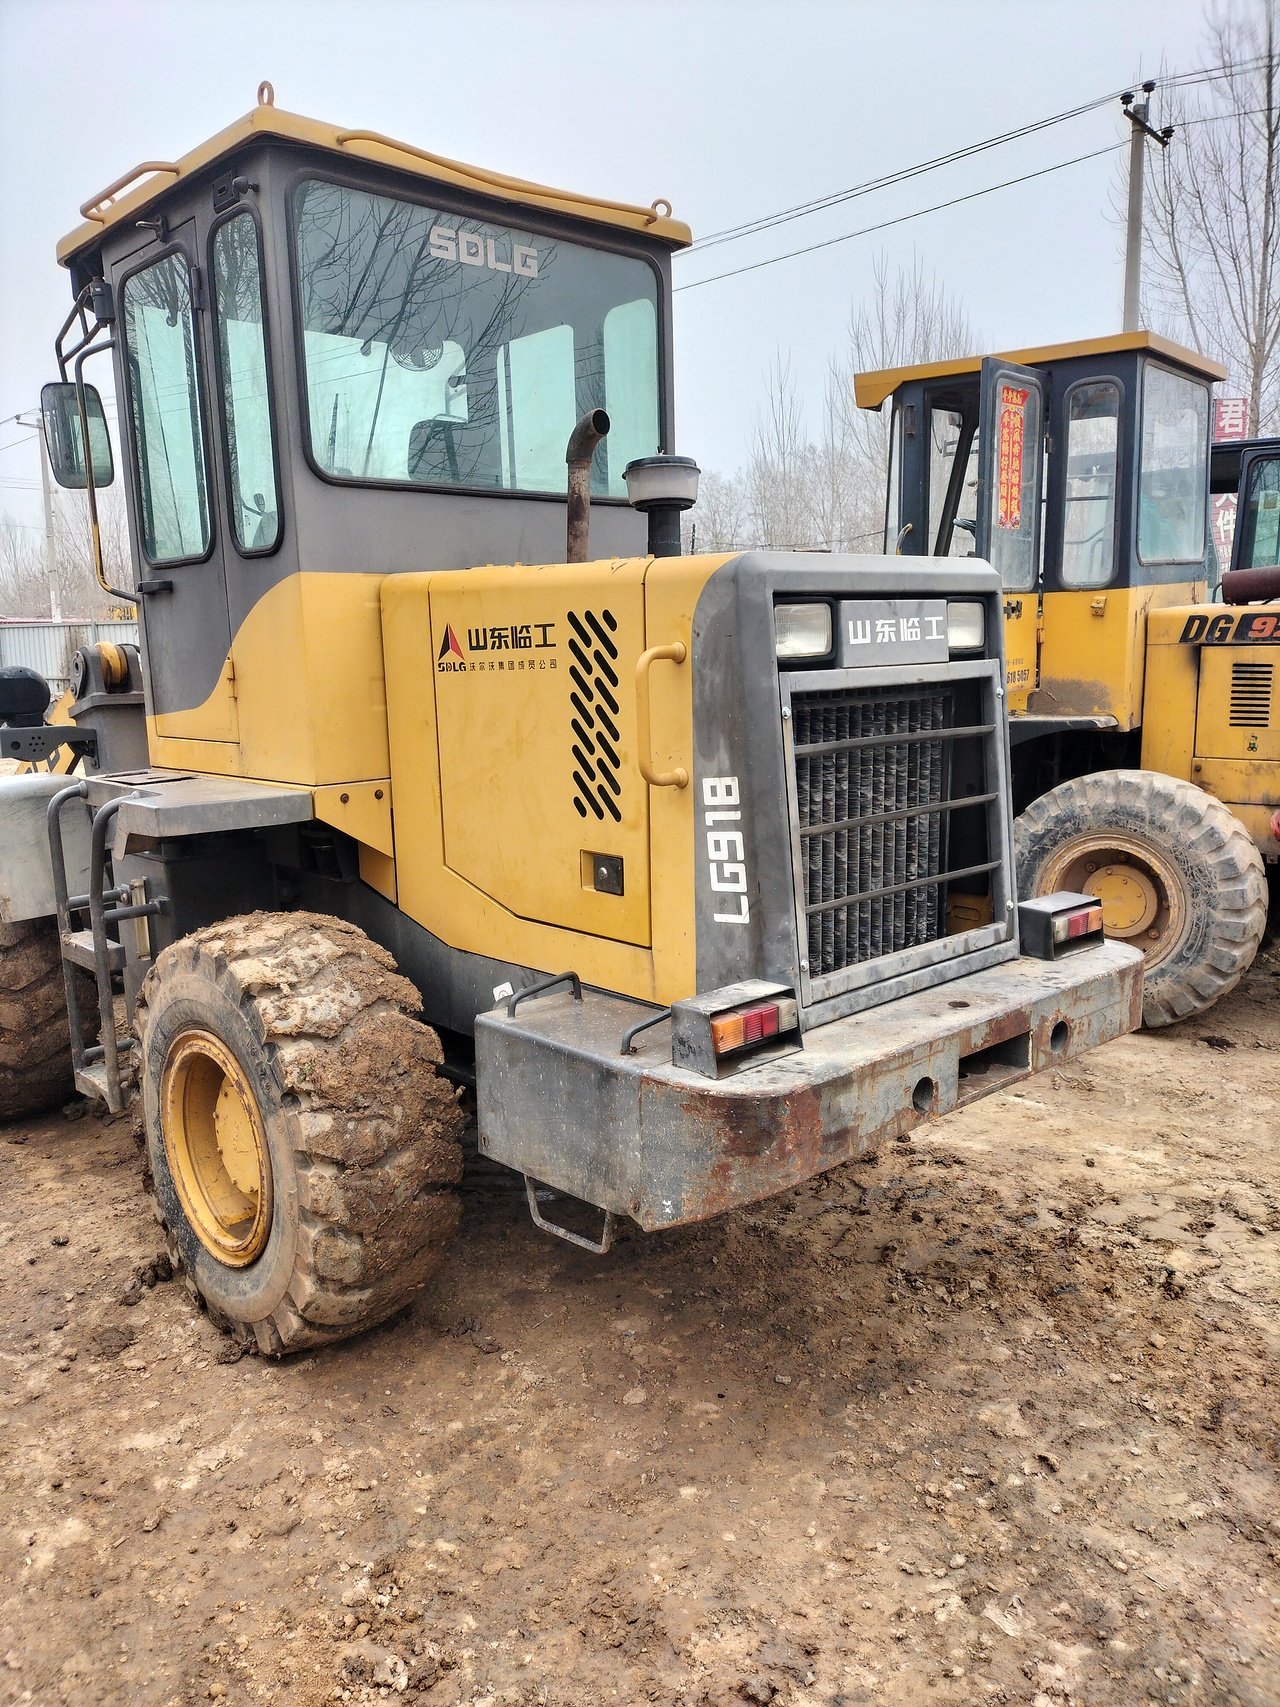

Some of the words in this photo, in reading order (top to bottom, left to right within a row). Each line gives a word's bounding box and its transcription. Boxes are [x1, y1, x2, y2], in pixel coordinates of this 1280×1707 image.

[429, 224, 539, 278] SDLG
[467, 623, 557, 651] 山东临工
[848, 615, 945, 645] 山东临工
[1179, 614, 1235, 643] DG
[438, 662, 467, 673] SDLG
[469, 659, 558, 673] 沃尔沃集团成员公司
[702, 776, 750, 925] LG918
